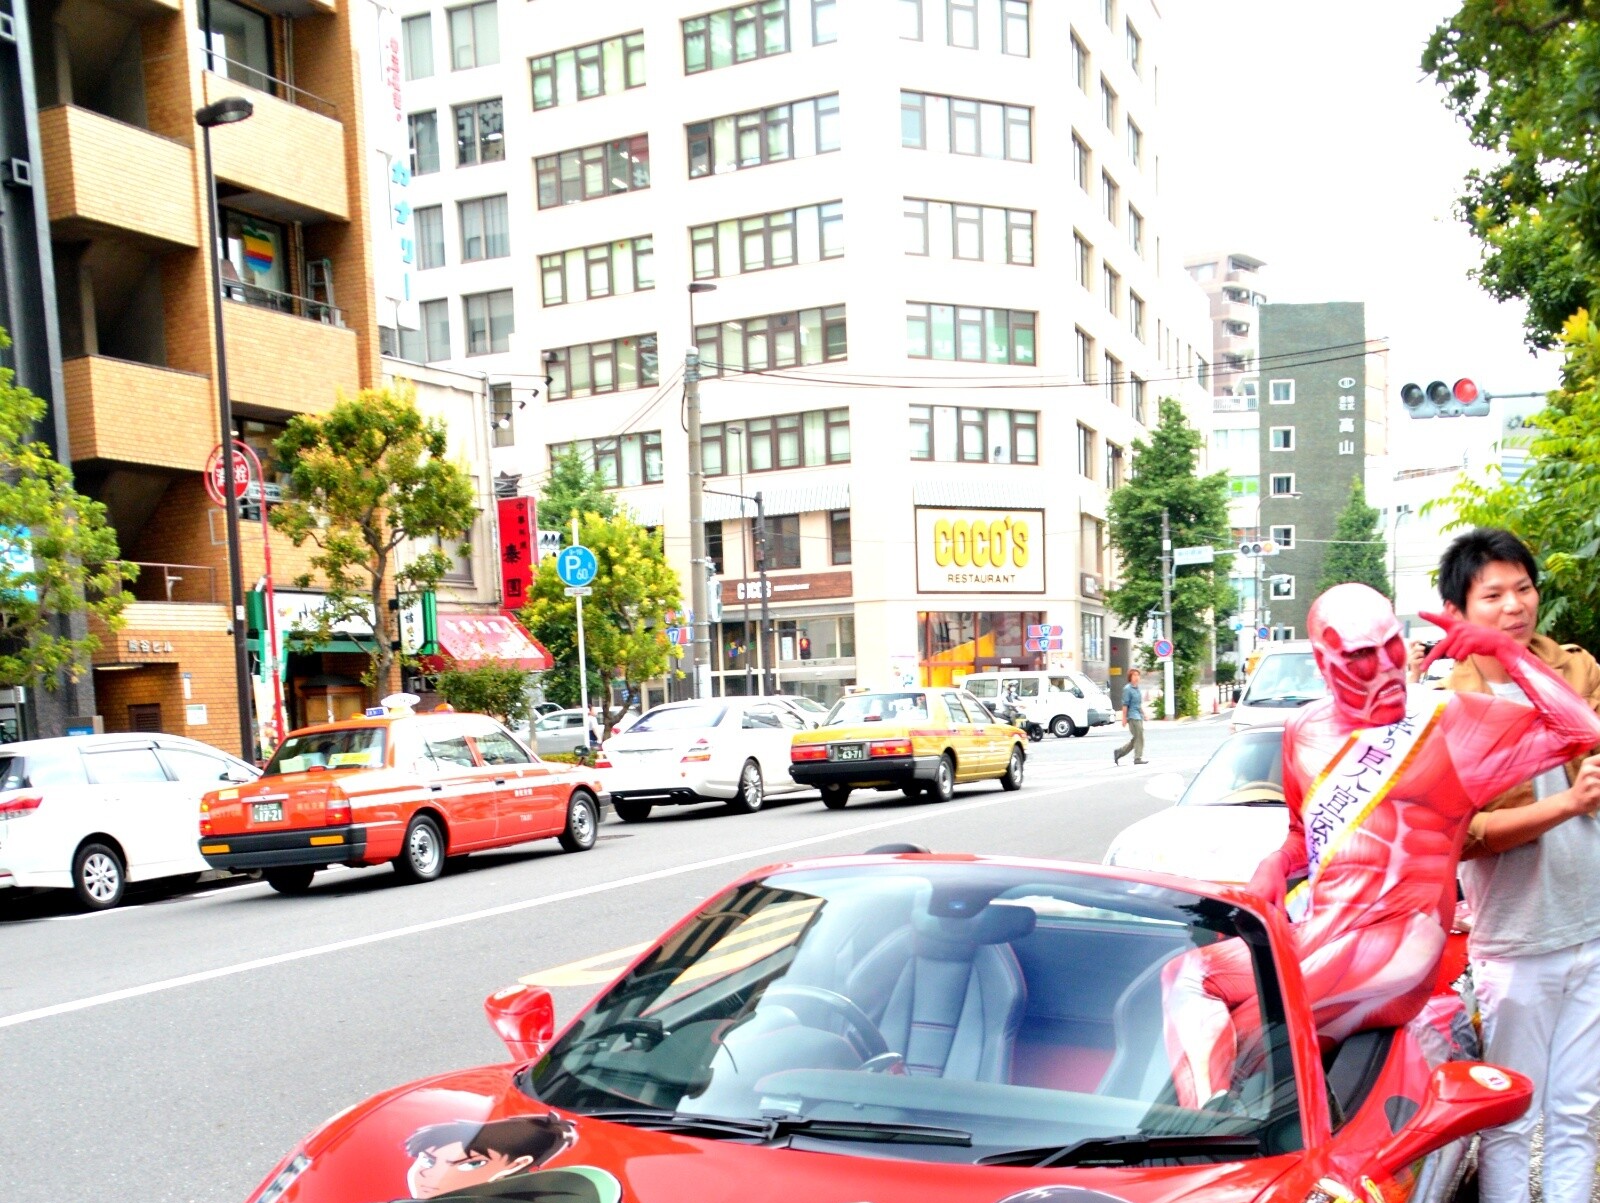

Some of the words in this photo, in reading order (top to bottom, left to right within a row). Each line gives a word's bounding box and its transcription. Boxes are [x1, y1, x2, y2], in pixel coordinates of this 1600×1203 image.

[215, 464, 248, 487] 消栓
[934, 515, 1029, 568] COCO'S
[565, 555, 581, 580] P
[947, 573, 1017, 584] RESTAURANT
